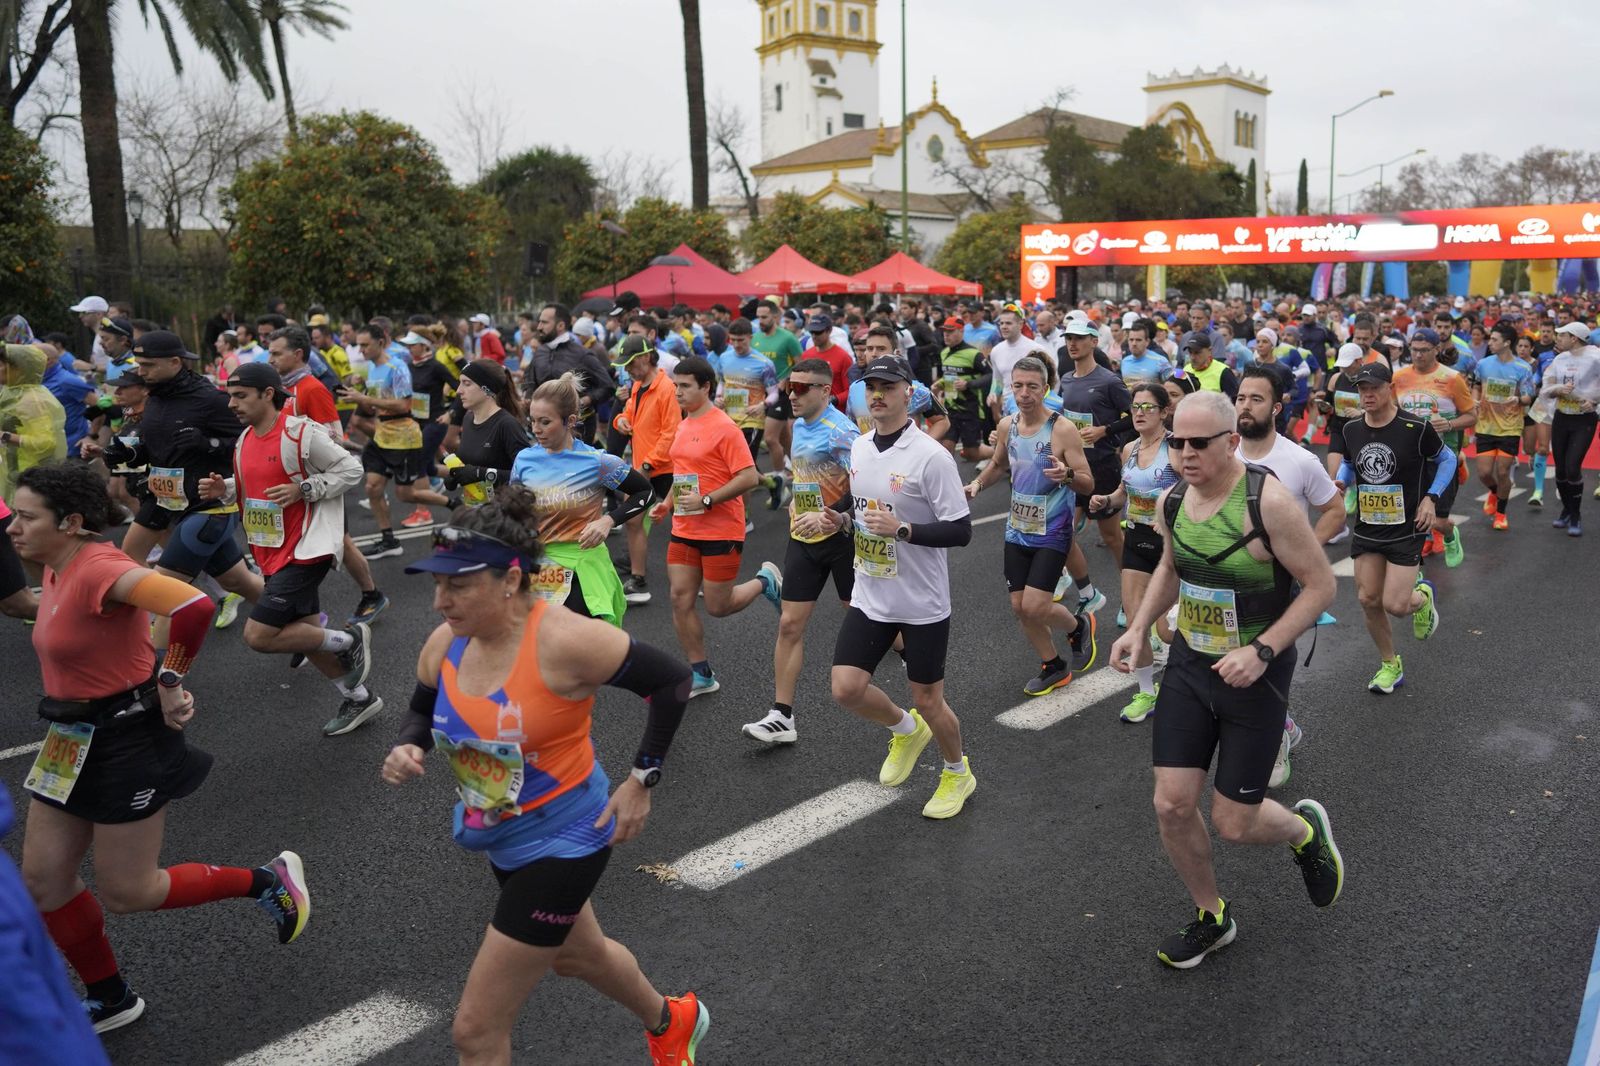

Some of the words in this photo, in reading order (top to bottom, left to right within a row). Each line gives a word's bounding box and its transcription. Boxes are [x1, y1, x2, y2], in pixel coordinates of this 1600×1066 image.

[1444, 224, 1501, 243] HOKA
[152, 478, 174, 493] 6219
[1363, 494, 1395, 507] 15761
[247, 510, 274, 527] 13361
[1182, 598, 1225, 626] 13128
[276, 885, 298, 915] HOKA
